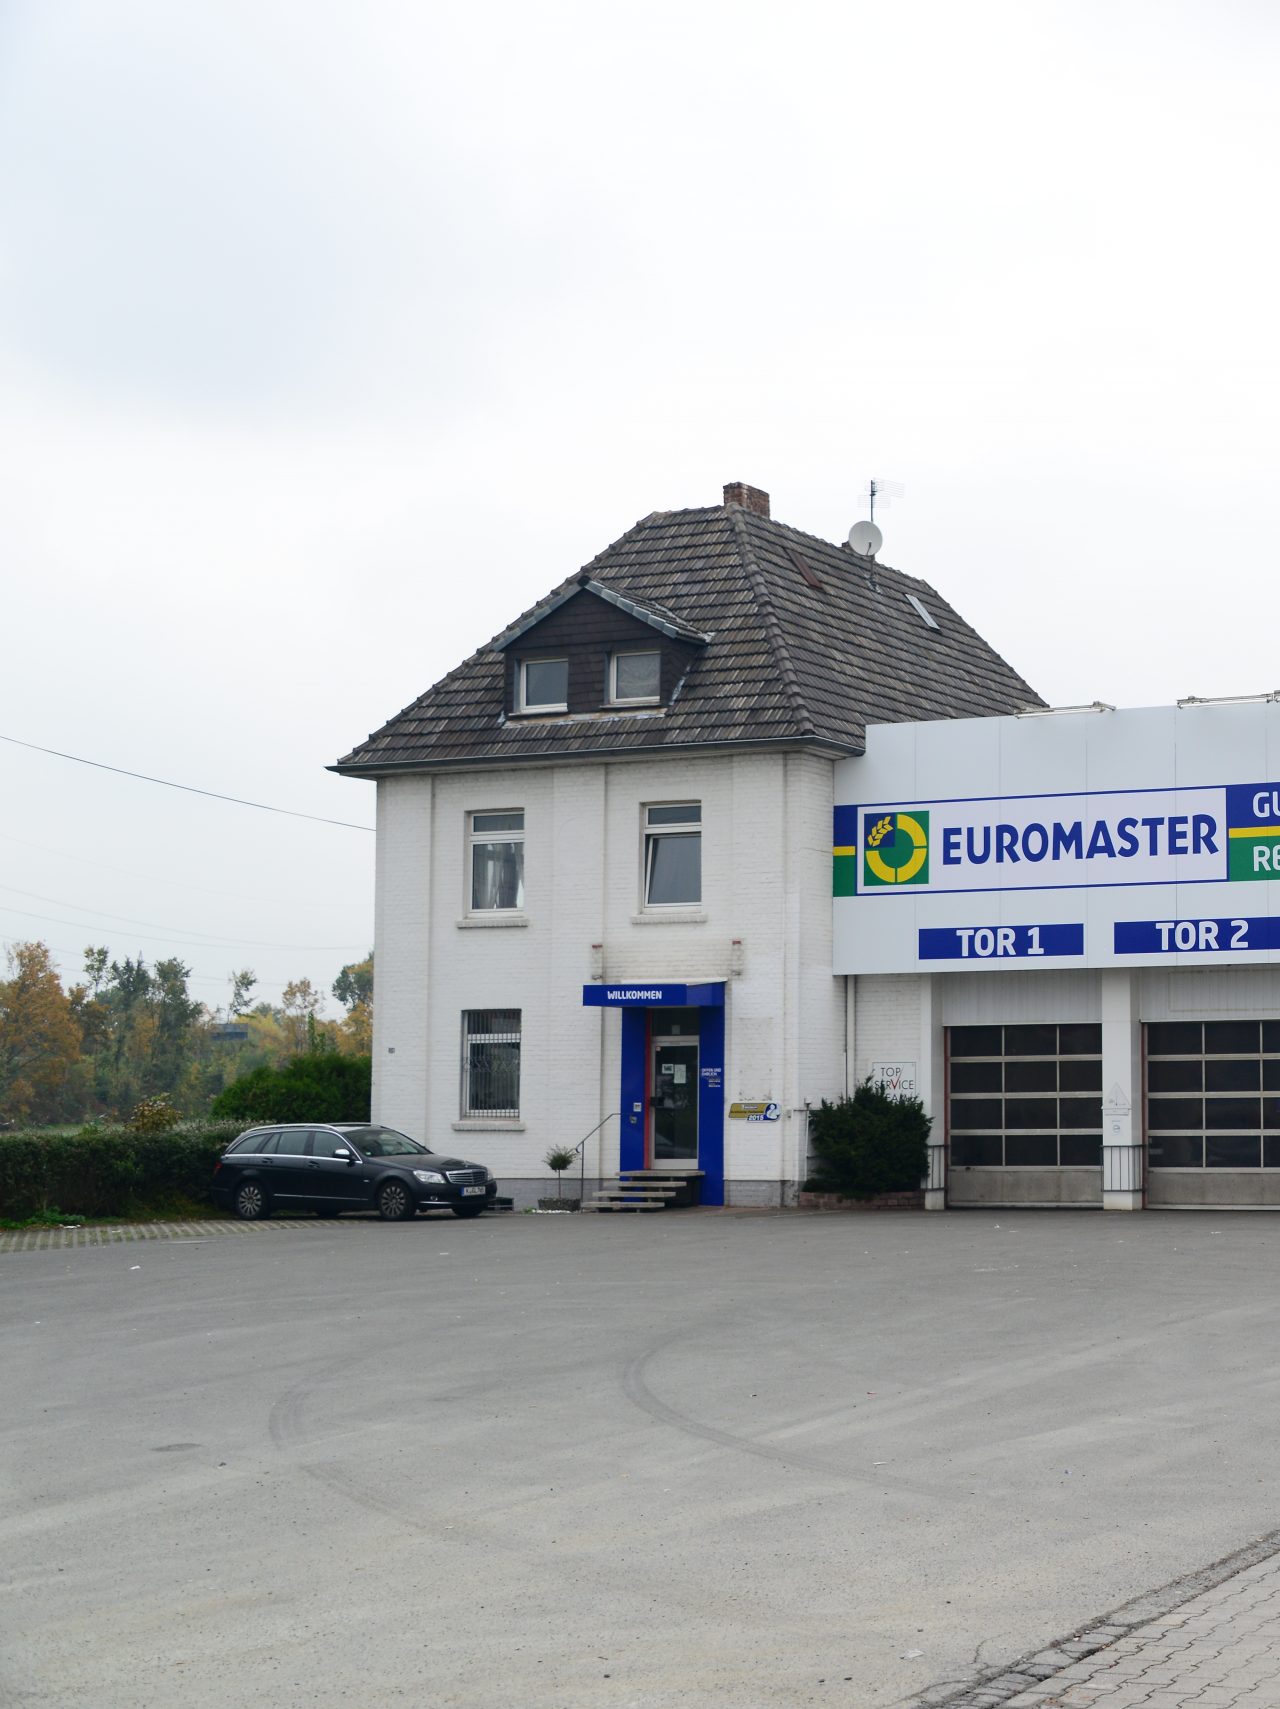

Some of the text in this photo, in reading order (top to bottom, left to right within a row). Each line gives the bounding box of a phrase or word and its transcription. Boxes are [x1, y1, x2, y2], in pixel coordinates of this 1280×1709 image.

[942, 813, 1220, 866] EUROMASTER
[956, 927, 1045, 957] TOR 1
[1155, 919, 1249, 951] TOR 2
[607, 990, 662, 1000] WILLKOMMEN
[880, 1067, 901, 1077] TOP
